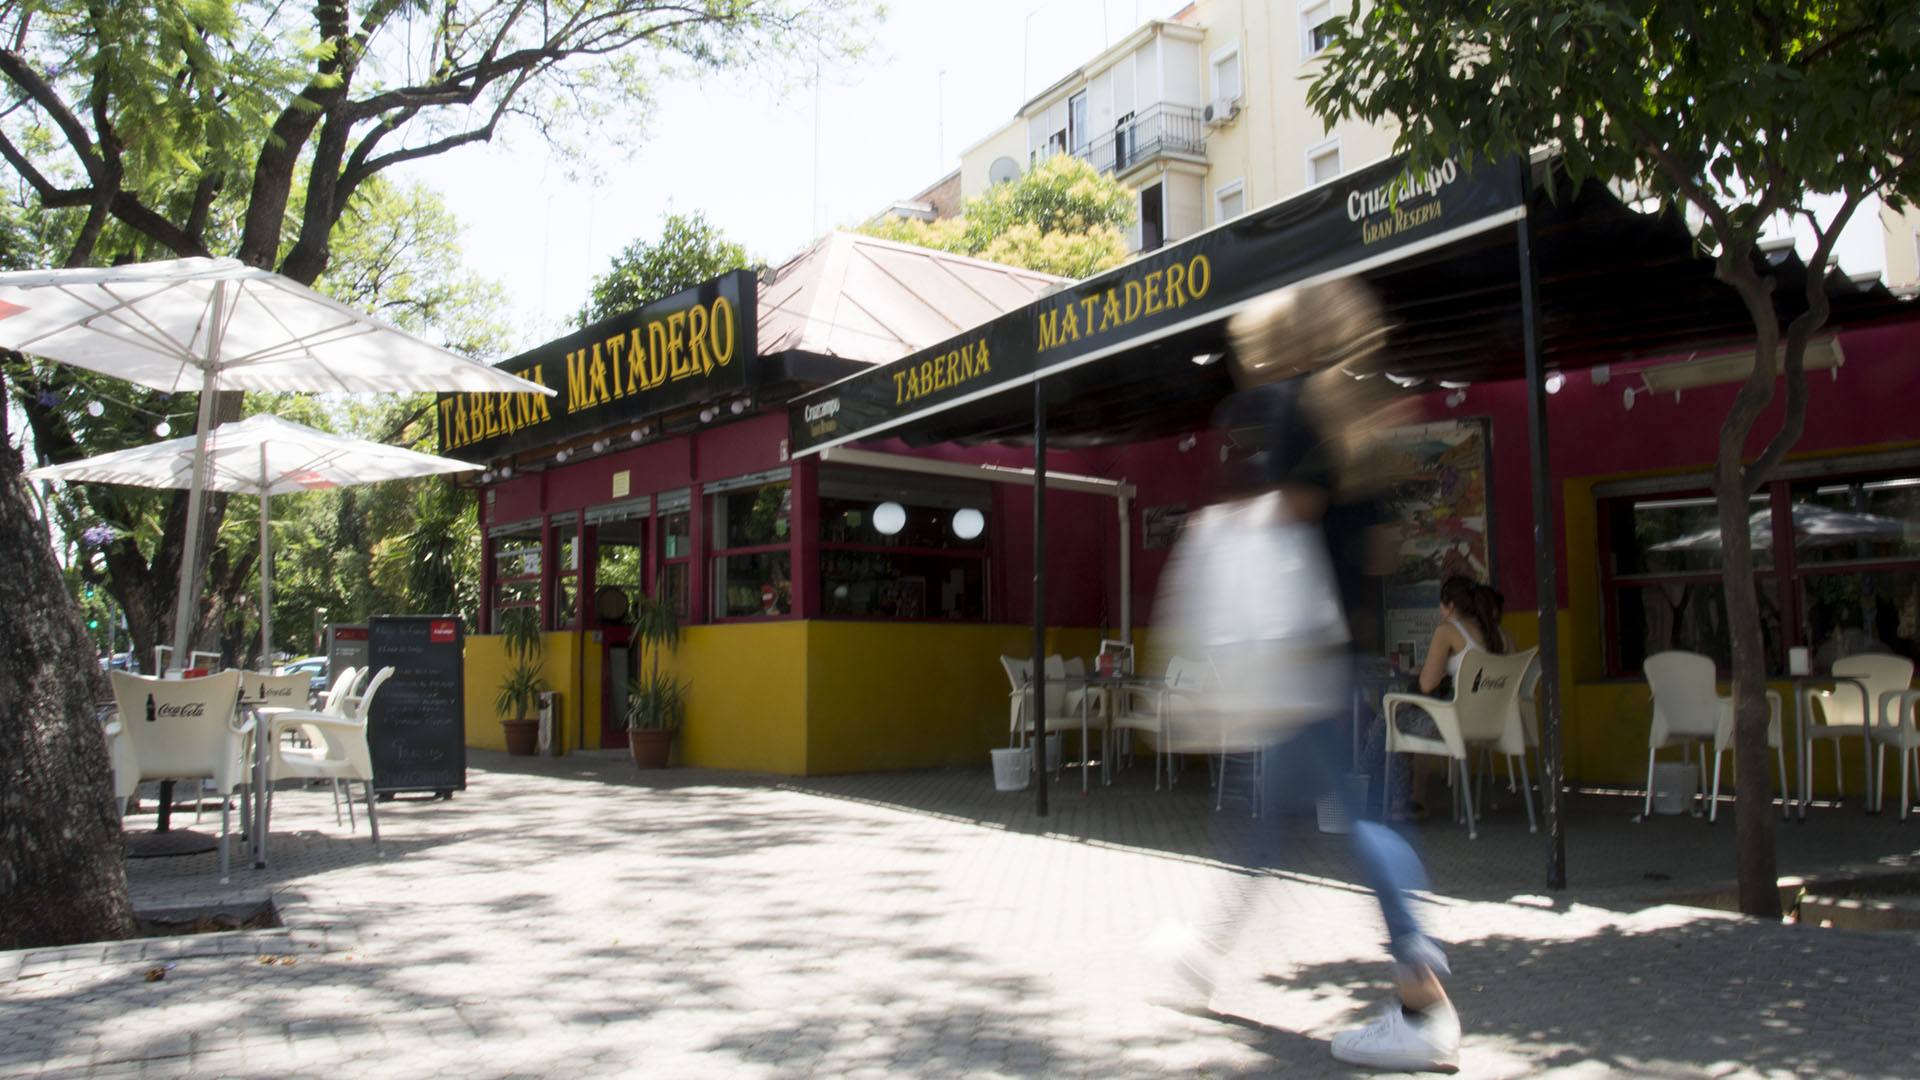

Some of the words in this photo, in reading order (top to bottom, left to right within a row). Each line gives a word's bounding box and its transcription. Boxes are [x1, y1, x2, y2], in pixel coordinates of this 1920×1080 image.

[1362, 217, 1393, 245] GRAN
[1395, 199, 1441, 234] RESERVA
[440, 363, 552, 451] TABERNA
[566, 295, 735, 415] MATADERO
[893, 338, 991, 406] TABERNA
[1037, 254, 1211, 352] MATADERO
